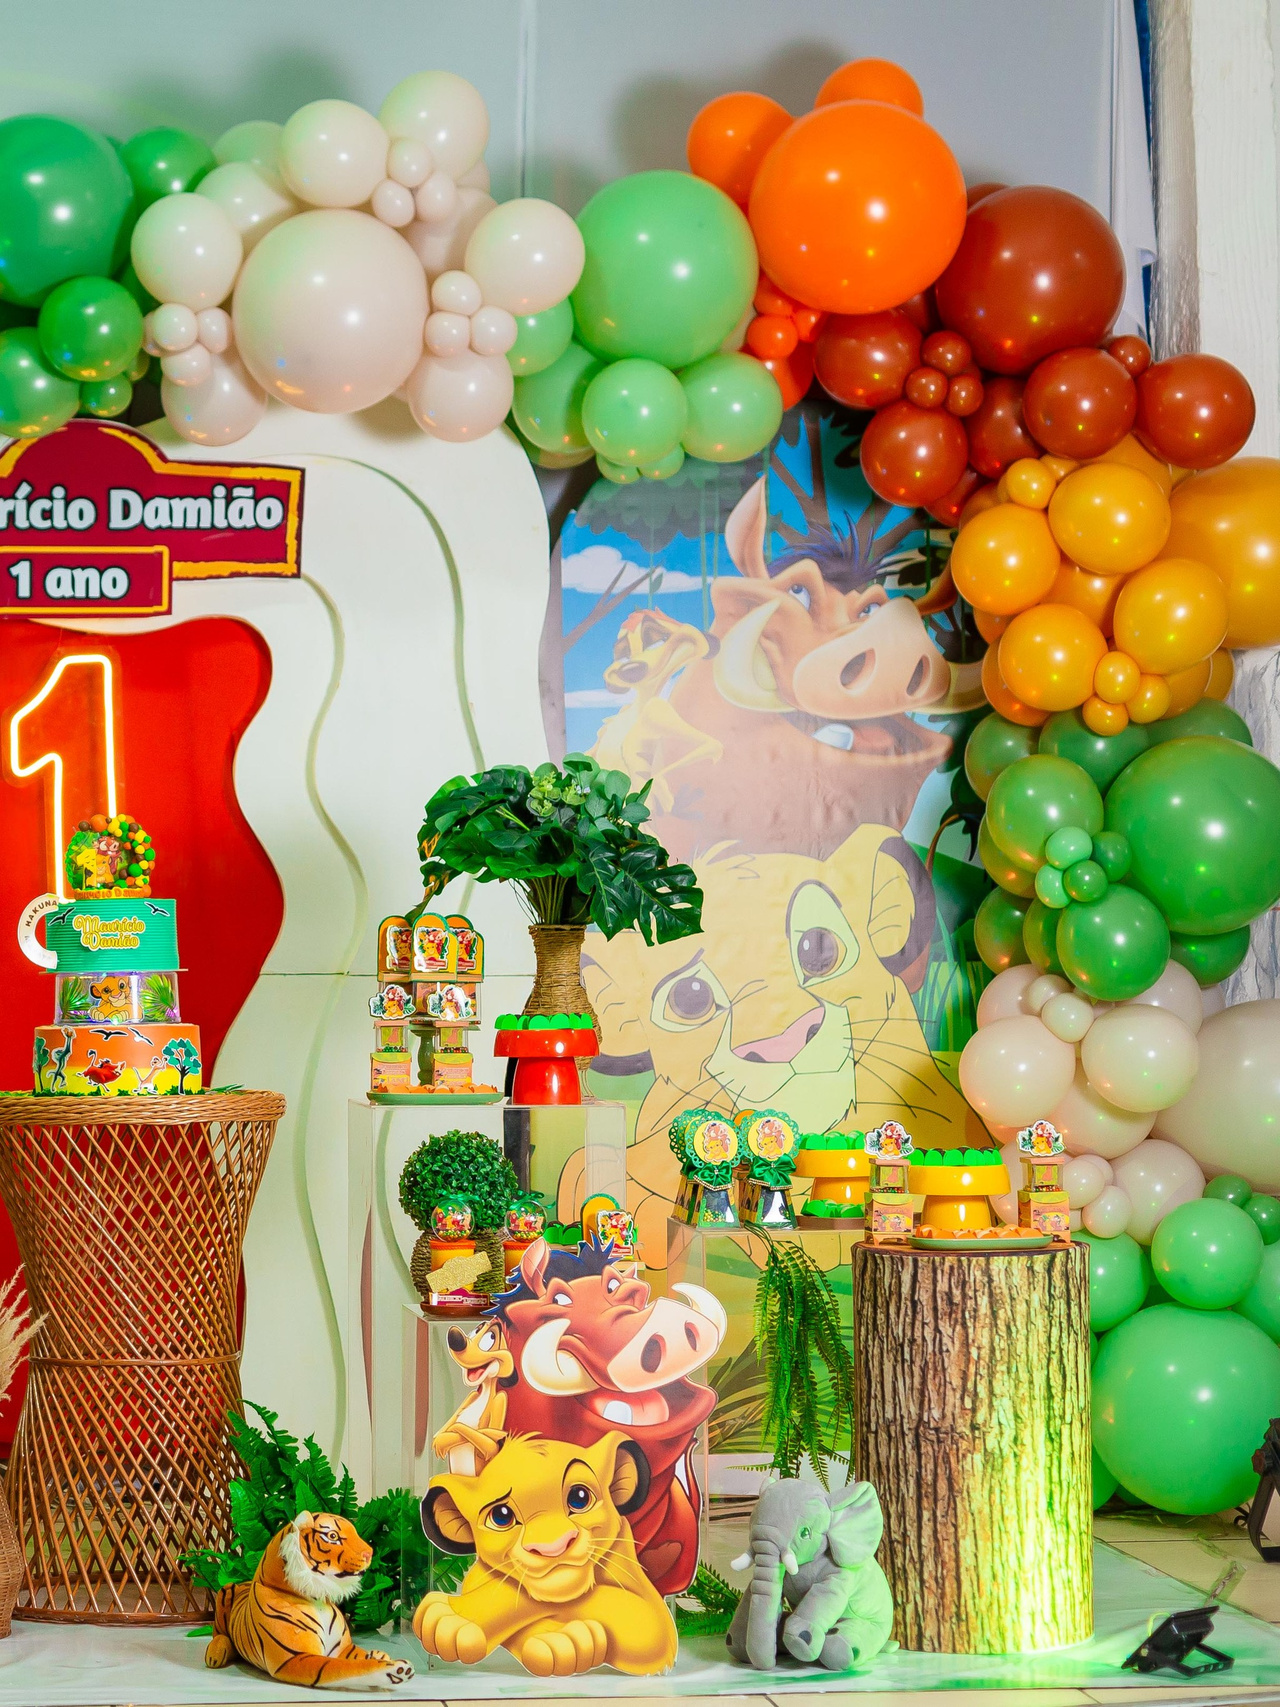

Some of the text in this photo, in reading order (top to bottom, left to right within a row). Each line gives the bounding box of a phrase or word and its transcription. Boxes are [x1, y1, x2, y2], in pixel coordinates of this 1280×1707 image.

[107, 484, 285, 531] Damião
[8, 558, 130, 599] 1 ano
[9, 653, 118, 904] 1
[25, 900, 58, 927] HAKUNA
